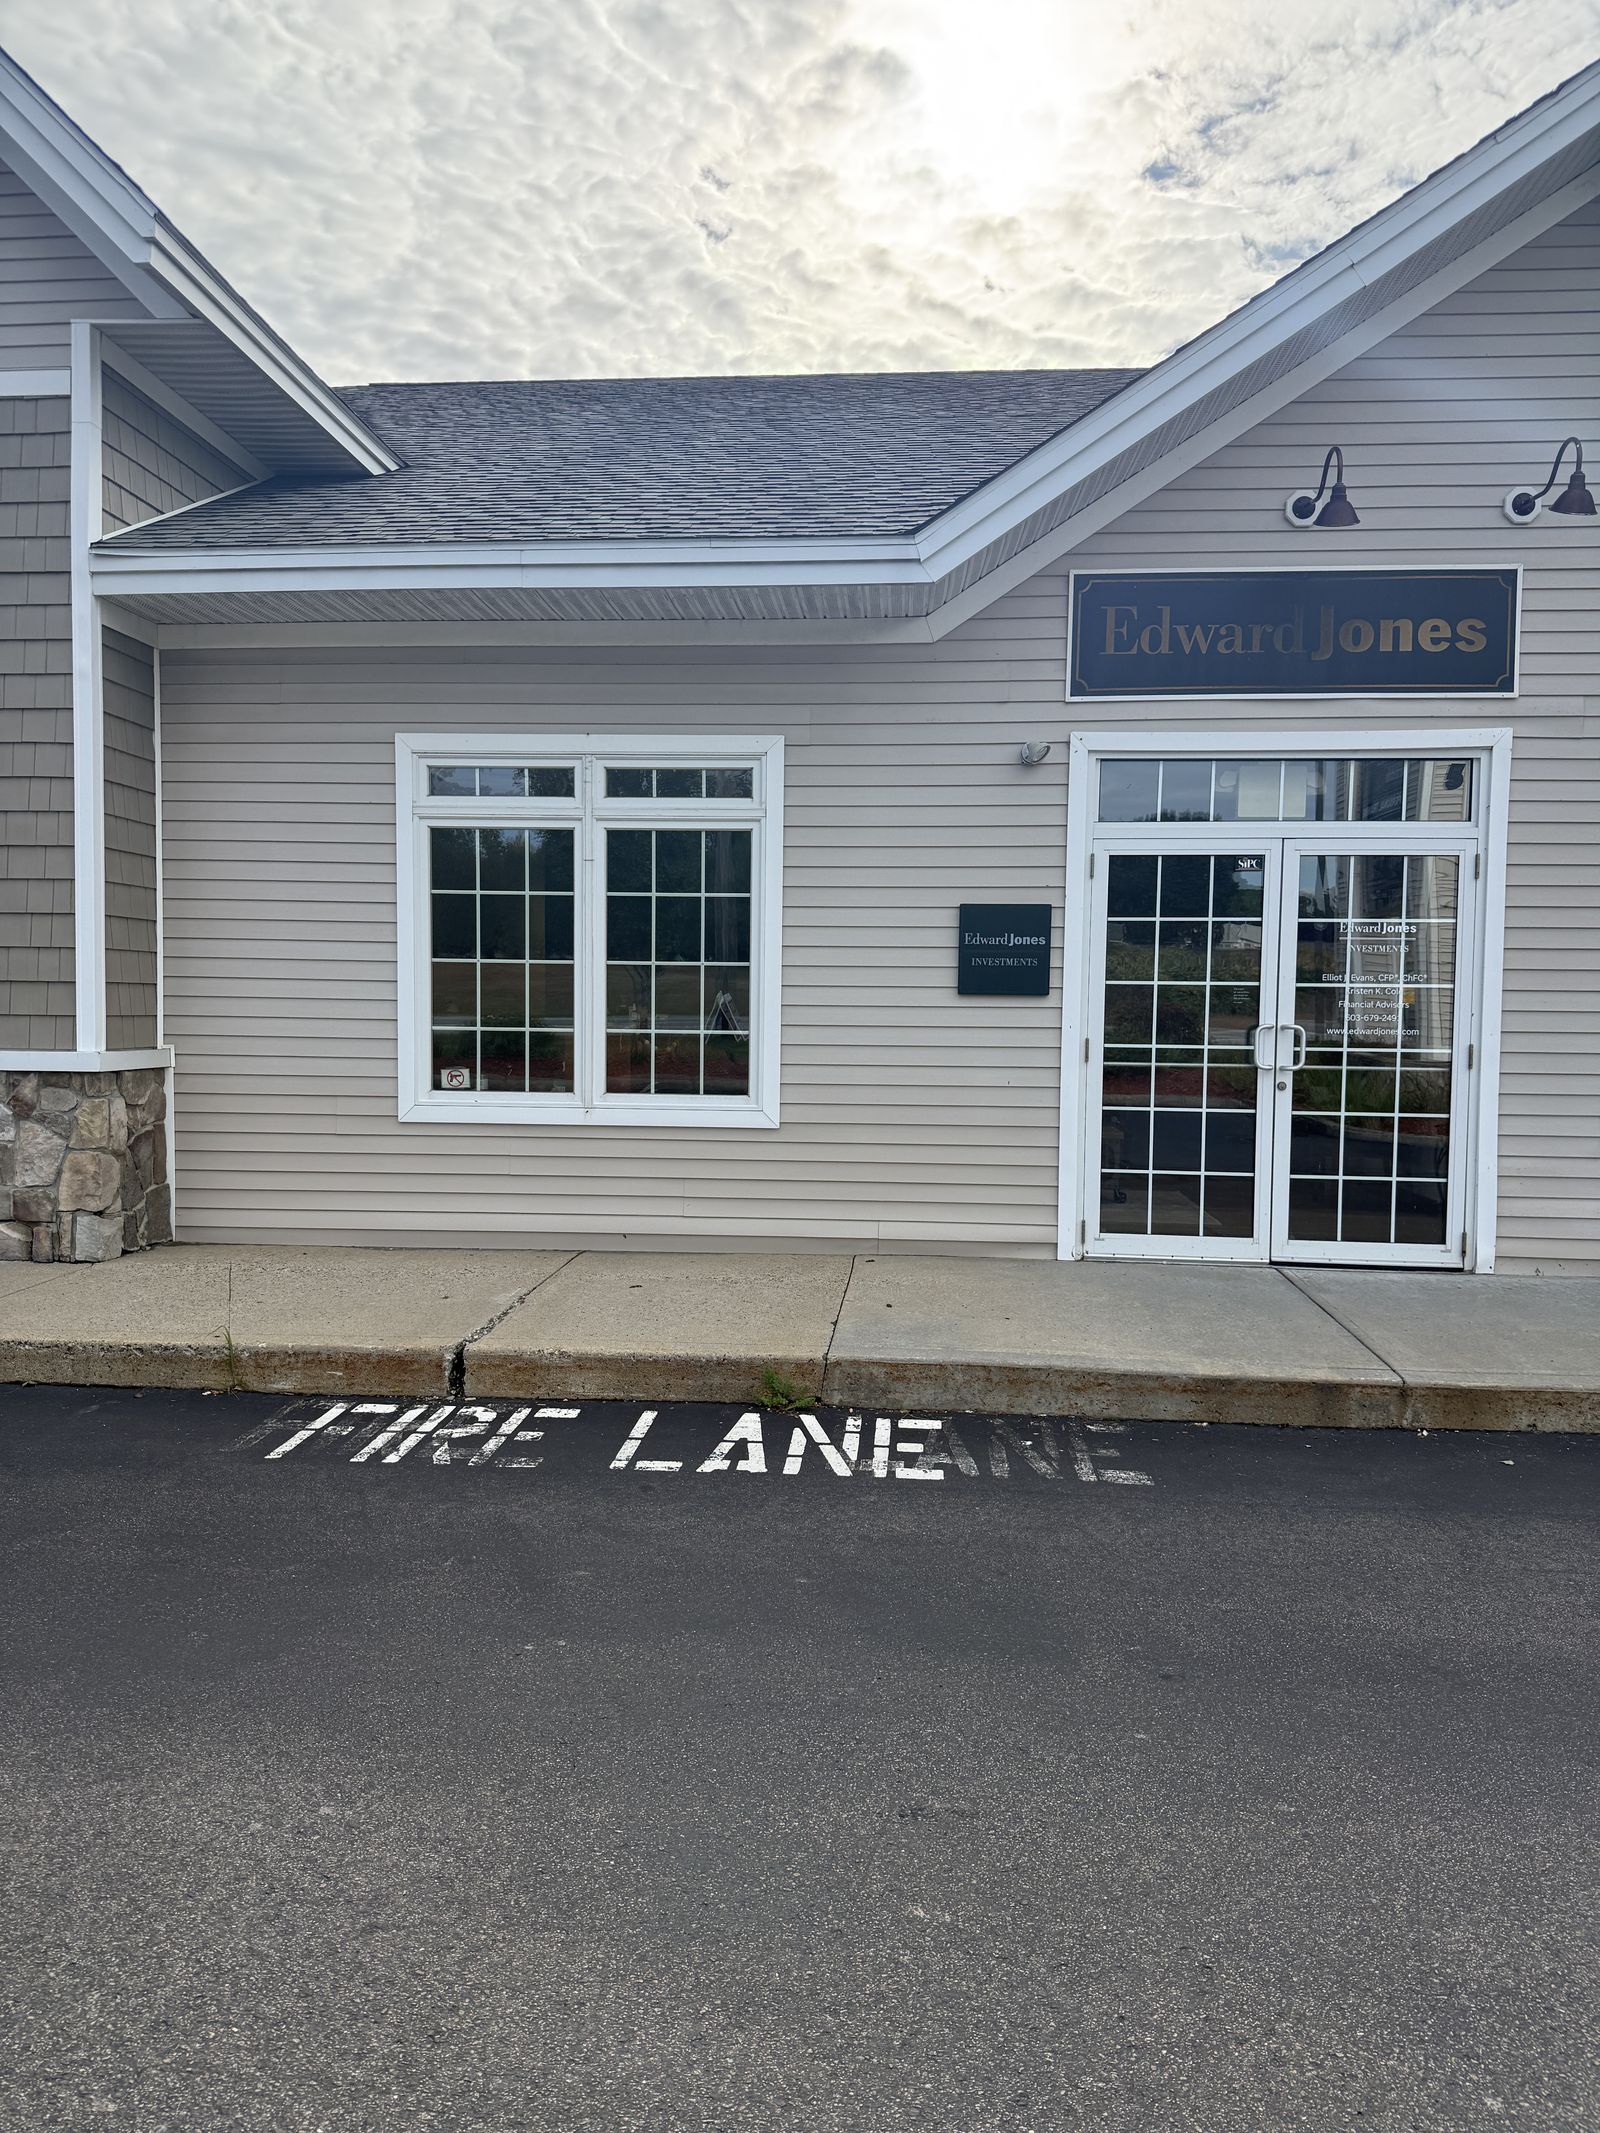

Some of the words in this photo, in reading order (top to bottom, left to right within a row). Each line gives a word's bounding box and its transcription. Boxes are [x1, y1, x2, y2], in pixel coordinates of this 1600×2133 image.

[971, 957, 1038, 967] INVESTMENTS
[1322, 973, 1343, 982] Elliot
[1350, 973, 1377, 983] Evans,
[1375, 987, 1384, 995] K.
[1326, 1027, 1420, 1037] www.edwardjonescom
[609, 1410, 944, 1480] LANE
